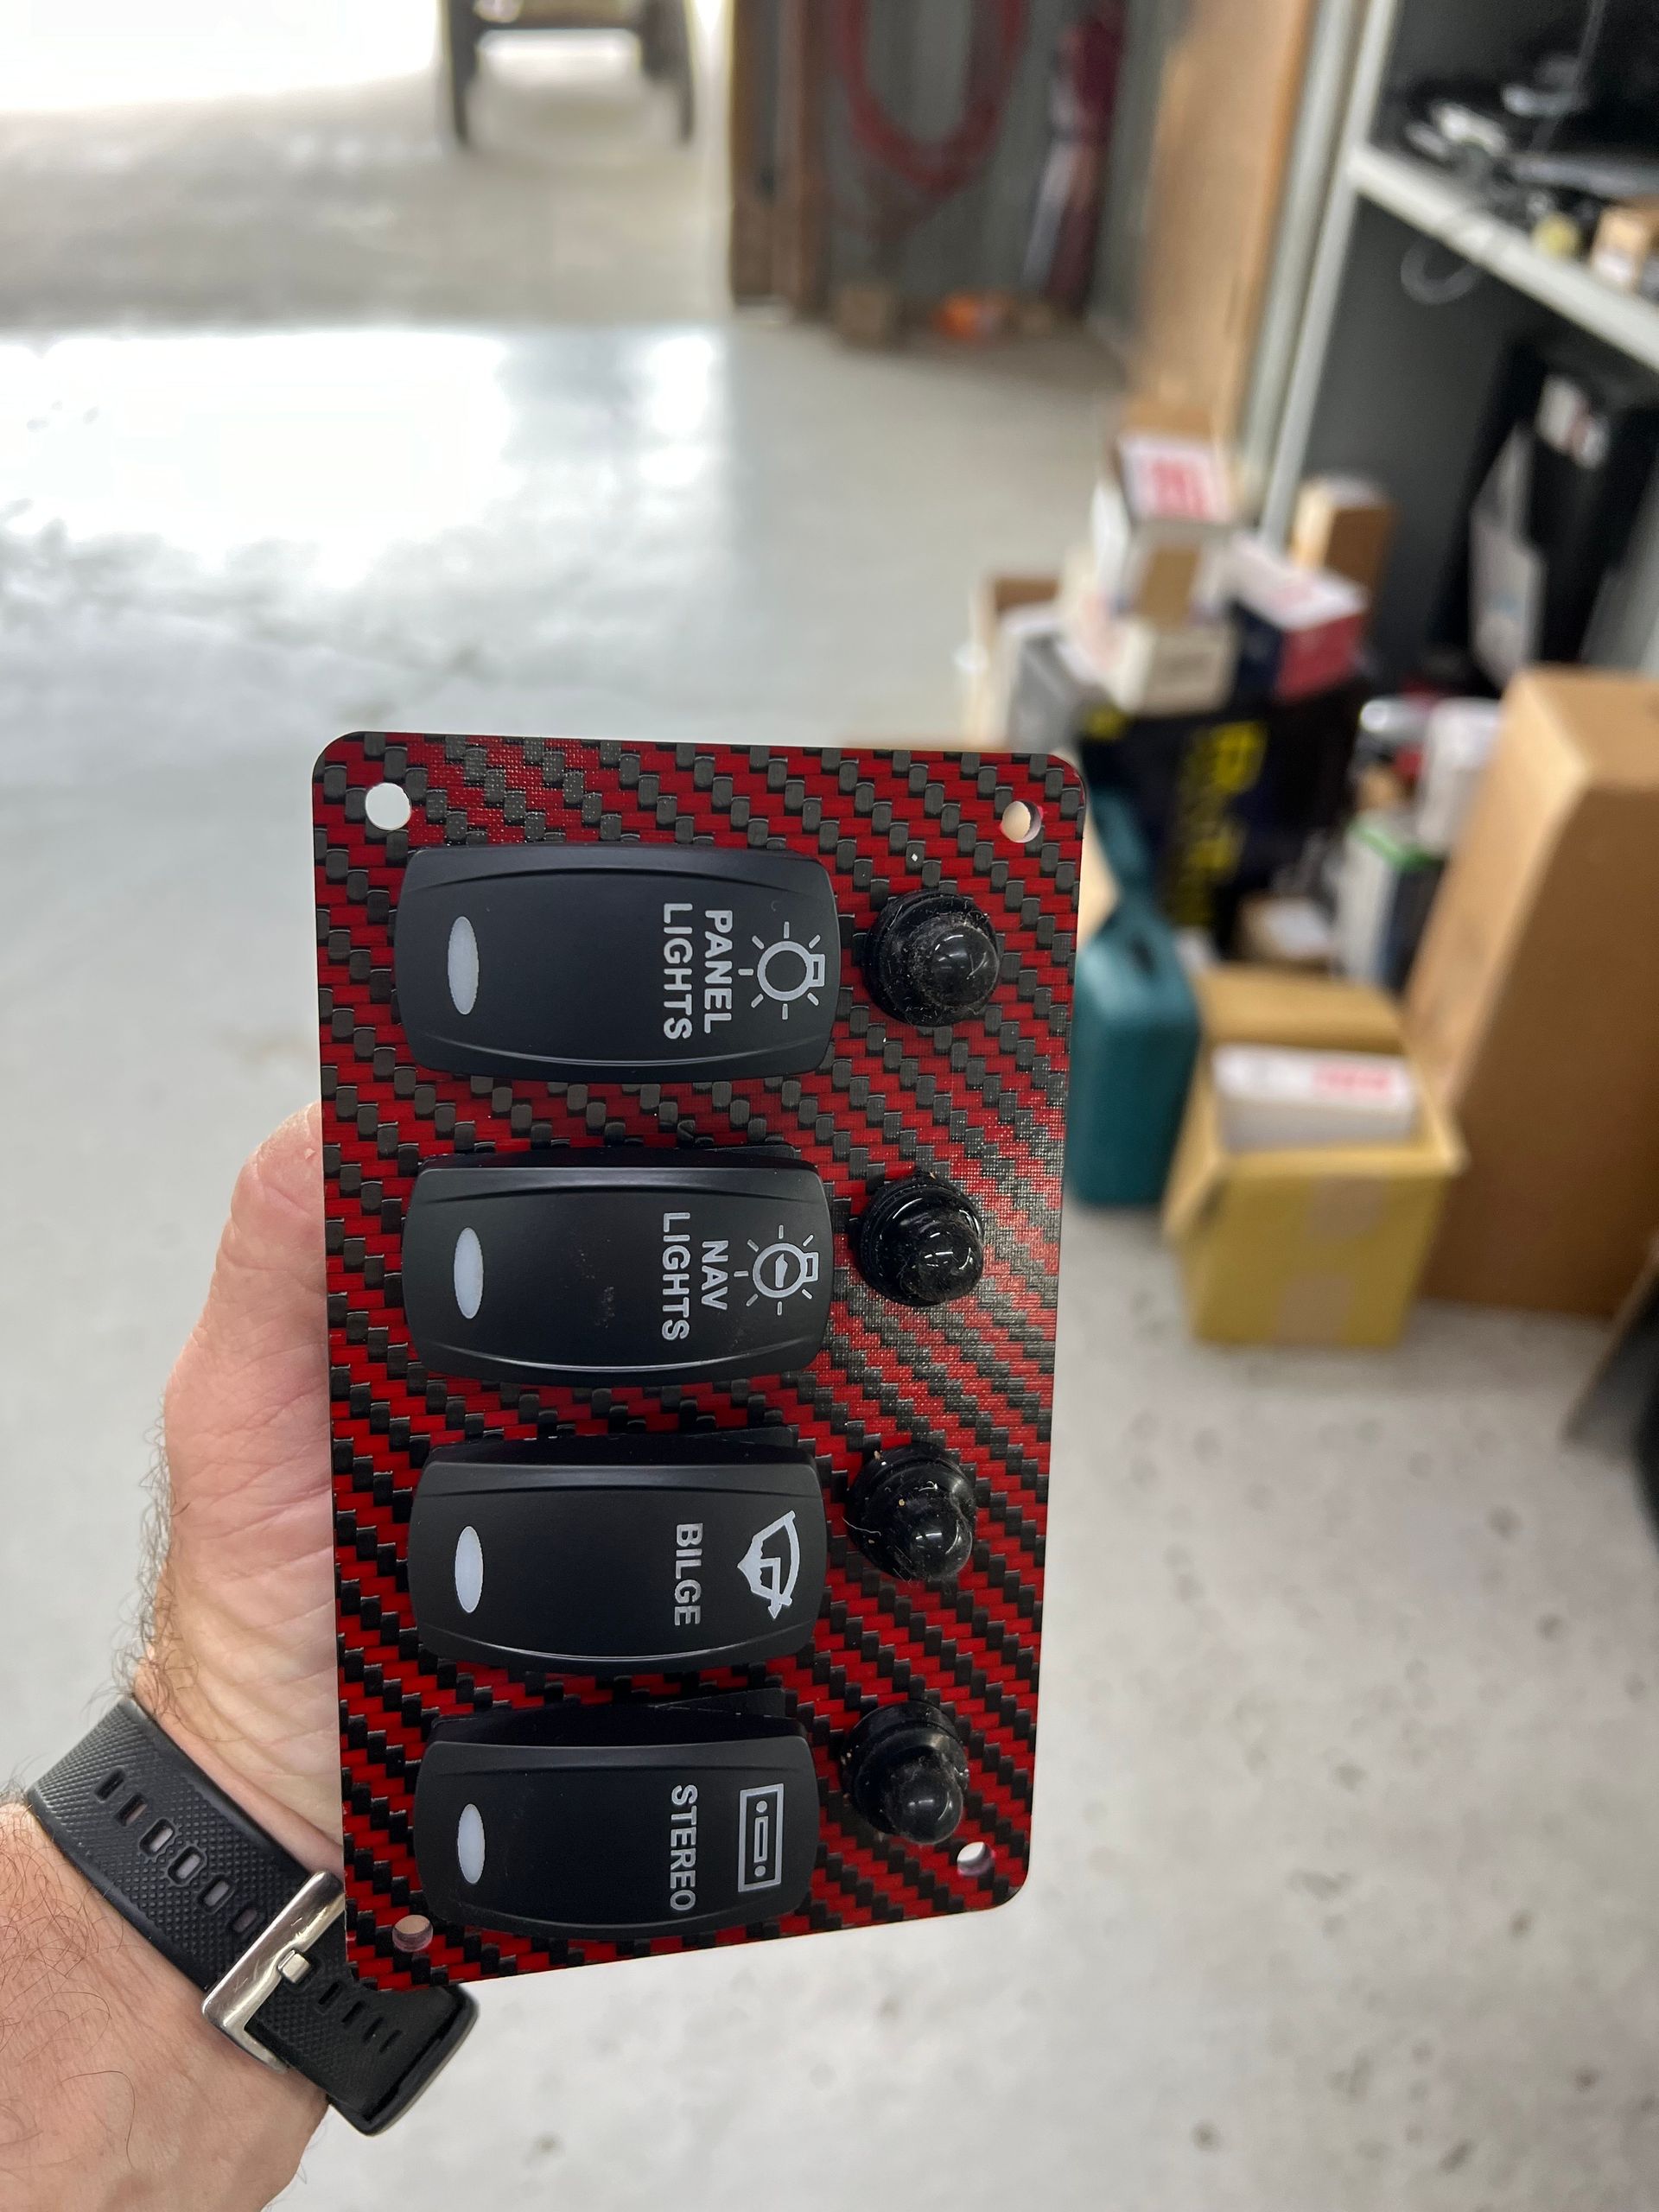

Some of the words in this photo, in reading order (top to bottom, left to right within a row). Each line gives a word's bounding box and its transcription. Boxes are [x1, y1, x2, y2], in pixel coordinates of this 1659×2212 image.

[663, 903, 693, 1039] LIGHTS
[704, 910, 733, 1033] PANEL
[661, 1211, 691, 1341] LIGHTS
[702, 1240, 729, 1311] NAV
[674, 1522, 703, 1626] BILGE
[670, 1783, 698, 1911] STEREO
